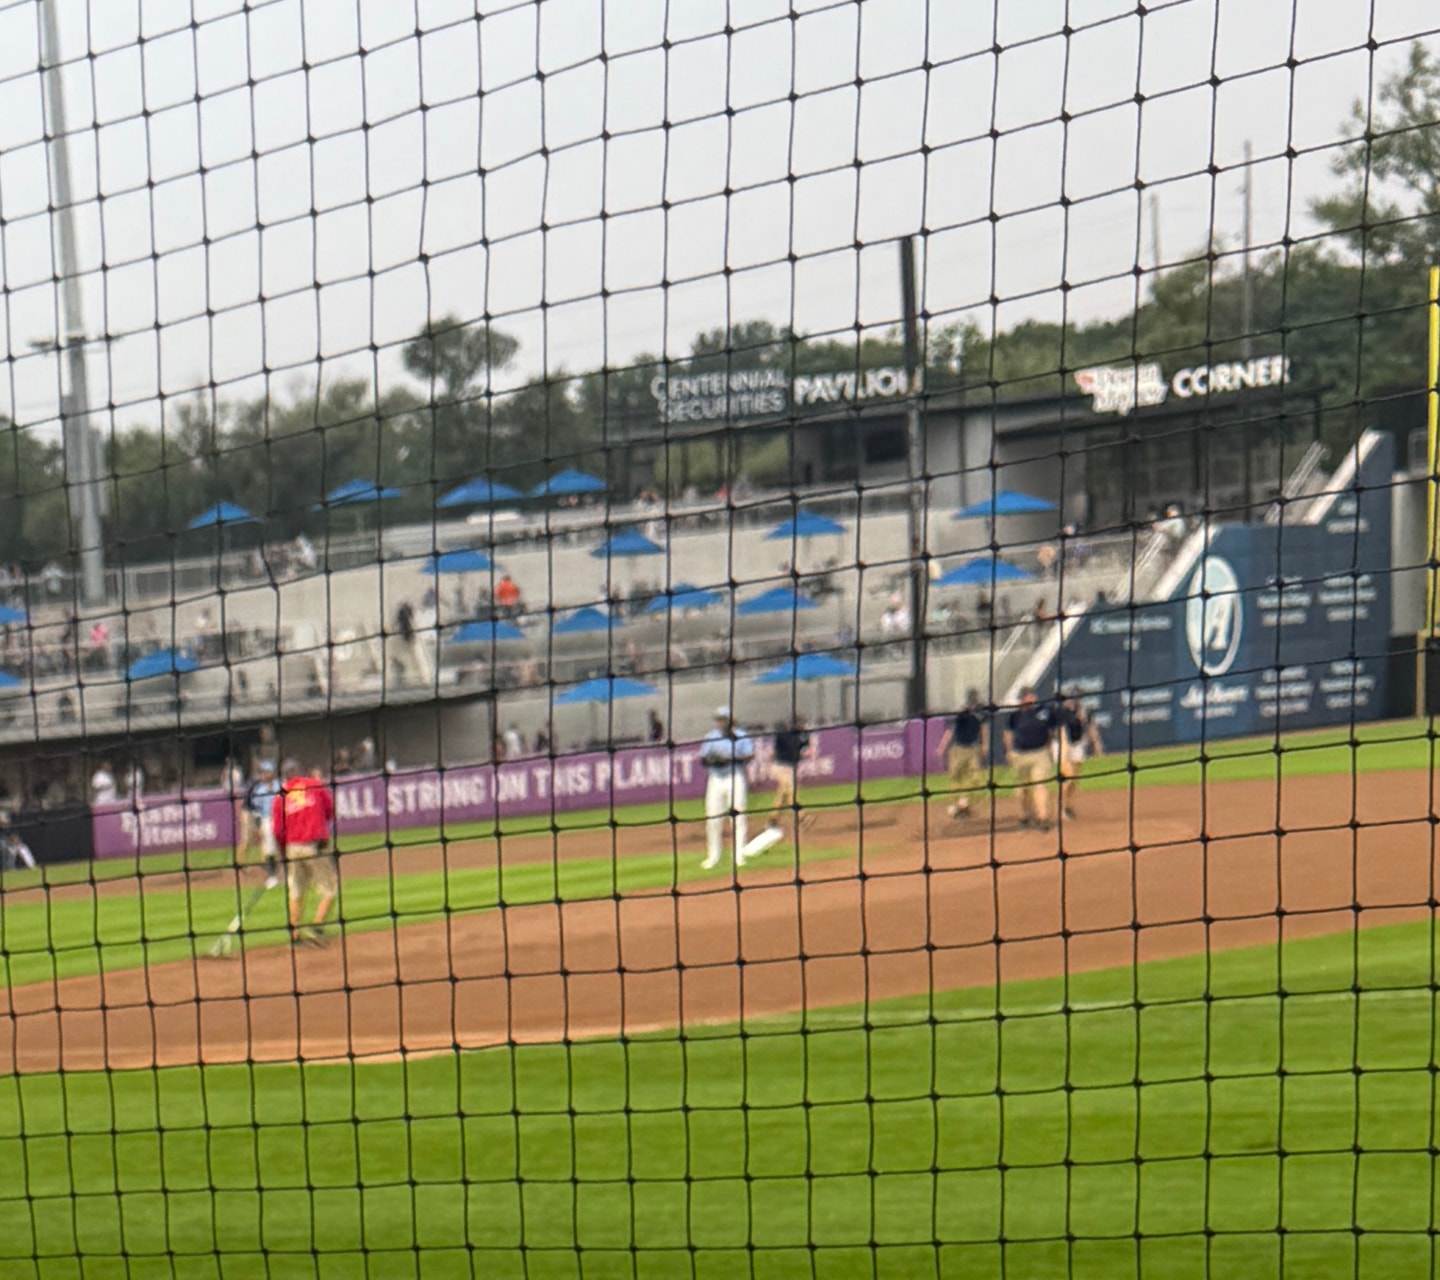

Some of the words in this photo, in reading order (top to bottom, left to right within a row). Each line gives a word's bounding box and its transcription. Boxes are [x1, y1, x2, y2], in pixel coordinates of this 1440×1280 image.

[1172, 355, 1291, 398] CORNER
[336, 788, 382, 821] ALL
[388, 774, 486, 816] STRONG
[492, 767, 529, 802] ON
[533, 761, 590, 797] THIS
[595, 753, 694, 789] PLANET
